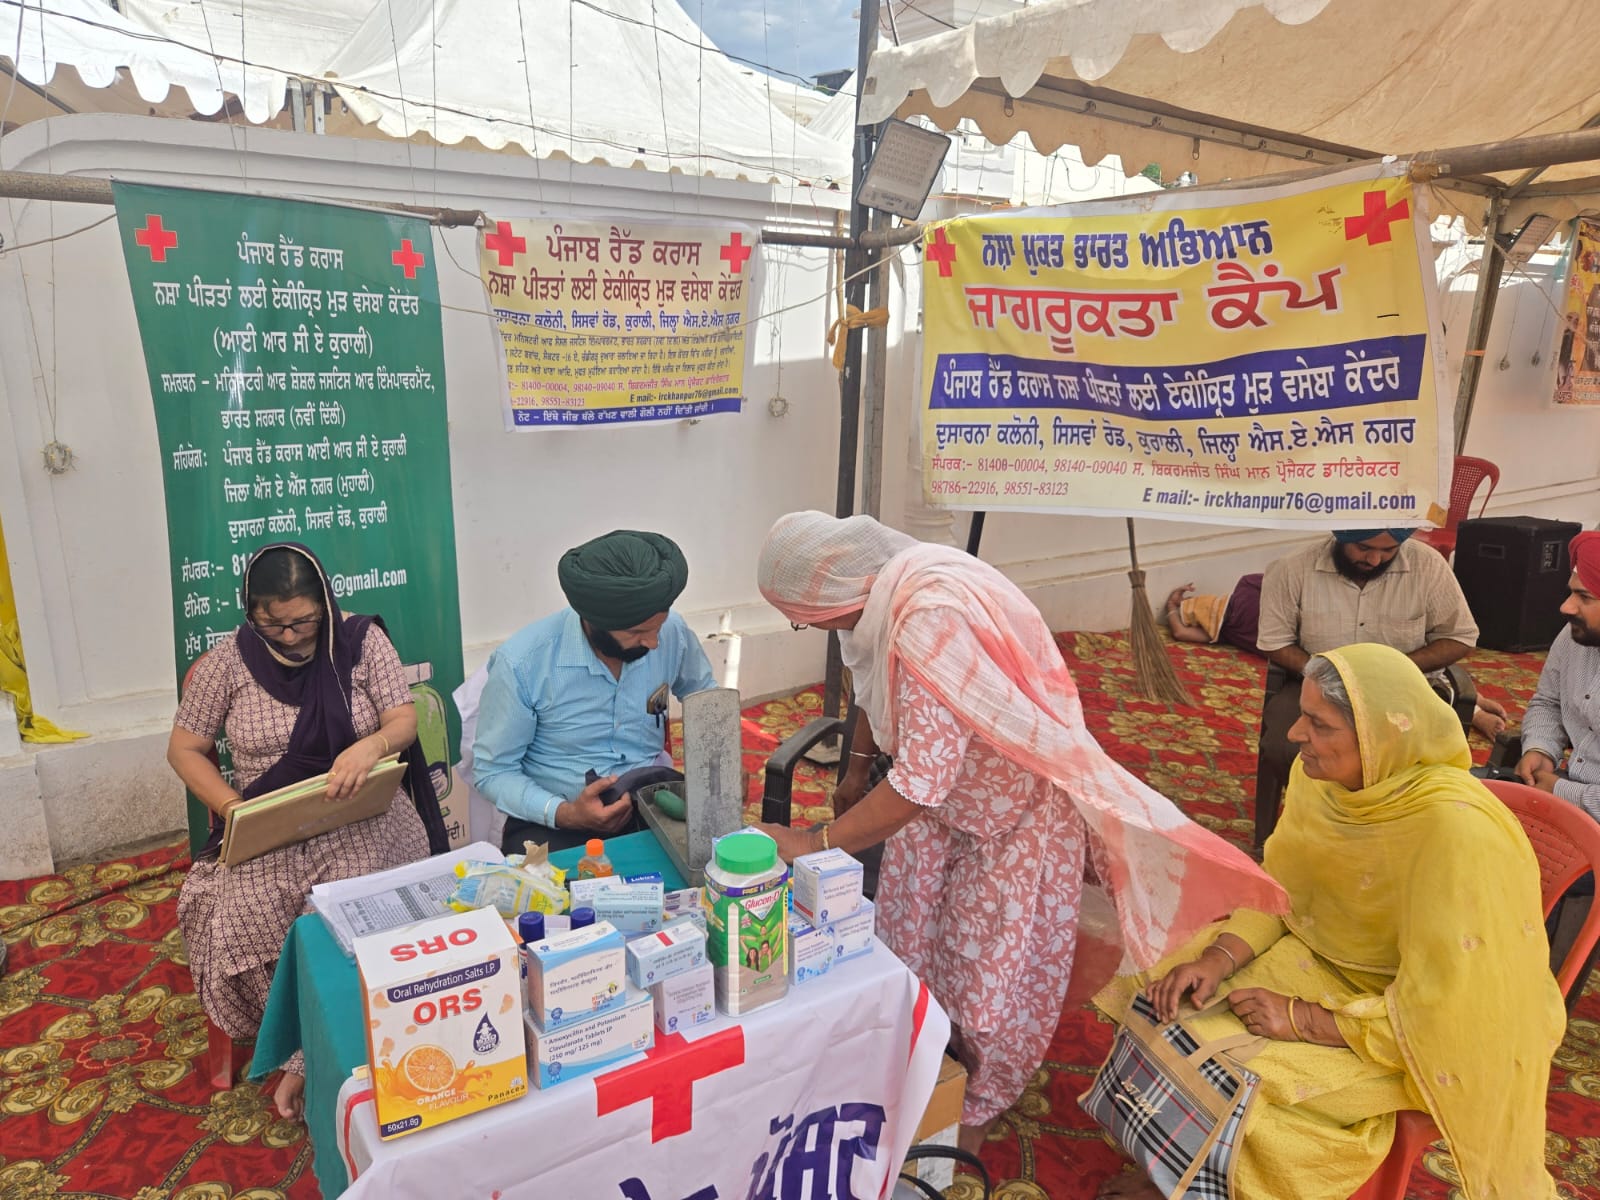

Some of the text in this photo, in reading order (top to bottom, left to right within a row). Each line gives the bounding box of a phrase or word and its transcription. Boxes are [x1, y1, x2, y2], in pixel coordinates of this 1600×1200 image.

[237, 232, 343, 270] ਪੰਜਾਬ ਰੈੱਡ ਕਰਾਸ
[546, 224, 701, 266] ਪੰਜਾਬ ਰੈੱਡ ਕਰਾਸ
[981, 217, 1272, 276] ਨਸ਼ਾ ਮੁਕਤ ਭਾਰਤ ਅਭਿਆਨ
[153, 282, 180, 306] ਨਸ਼ਾ
[187, 274, 231, 307] ਪੀੜਤਾਂ
[238, 278, 267, 308] ਲਈ
[327, 290, 347, 317] ਮੁੜ
[352, 285, 383, 314] ਵਸੇਬਾ
[388, 287, 418, 315] ਕੇਂਦਰ
[488, 270, 516, 297] ਨਸ਼ਾ
[522, 268, 565, 301] ਪੀੜਤਾਂ
[571, 269, 597, 301] ਲਈ
[656, 280, 676, 307] ਮੁੜ
[681, 272, 713, 302] ਵਸੇਬਾ
[718, 272, 742, 299] ਕੇਂਦਰ
[572, 310, 599, 328] ਸਿਸਵਾਂ
[602, 310, 620, 330] ਰੋਡ,
[964, 262, 1341, 354] ਜਾਗਰੂਕਤਾ ਕੈਂਪ
[213, 323, 373, 359] (ਆਈ ਆਰ ਸੀ ਏ ਕੁਰਾਲੀ)
[161, 373, 196, 393] ਸਮਰਥਨ
[267, 372, 286, 392] ਆਫ
[319, 366, 351, 391] ਜਸਟਿਸ
[354, 371, 374, 390] ਆਫ
[944, 358, 983, 400] ਪੰਜਾਬ
[988, 358, 1012, 400] ਰੈੱਡ
[1017, 370, 1052, 400] ਕਰਾਸ
[1053, 374, 1080, 400] ਨਸ਼ਾ
[1082, 368, 1121, 407] ਪੀੜਤਾਂ
[1126, 373, 1161, 411] ਲਈ
[1243, 372, 1273, 414] ਮੁੜ
[1280, 356, 1335, 402] ਵਸੇਬਾ
[1343, 350, 1400, 394] ਕੇਂਦਰ
[221, 410, 250, 429] ਭਾਰਤ
[255, 408, 285, 427] ਸਰਕਾਰ
[320, 401, 346, 428] ਦਿੱਲੀ)
[223, 442, 252, 466] ਪੰਜਾਬ
[257, 438, 272, 464] ਰੈੱਡ
[275, 444, 302, 462] ਕਰਾਸ
[307, 436, 329, 460] ਆਈ
[333, 440, 352, 459] ਆਰ
[356, 435, 367, 458] ਸੀ
[371, 436, 379, 456] ਏ
[382, 433, 407, 461] ਕੁਰਾਲੀ
[936, 424, 991, 450] ਦੁਸਾਰਨਾ
[998, 414, 1044, 450] ਕਲੋਨੀ,
[1053, 416, 1096, 446] ਸਿਸਵਾਂ
[1103, 418, 1133, 452] ਰੋਡ,
[1136, 427, 1193, 458] ਕੁਰਾਲੀ,
[1363, 418, 1416, 444] ਨਗਰ
[1053, 458, 1127, 475] 98140-09040
[1247, 466, 1270, 480] ਮਾਨ
[1323, 456, 1400, 478] ਡਾਇਰੈਕਟਰ
[275, 474, 284, 497] ਏ
[310, 477, 332, 495] ਨਗਰ
[932, 480, 1069, 496] 98786-22916, 98551-83123
[1143, 488, 1152, 502] E
[1204, 491, 1416, 513] irckhanpur76@gmail.com
[305, 506, 334, 530] ਸਿਸਵਾਂ
[337, 504, 355, 530] ਰੋਡ,
[359, 500, 387, 528] ਕੁਰਾਲੀ
[184, 592, 210, 618] ਈਮੇਲ
[328, 567, 407, 597] @gmail.com
[745, 890, 780, 910] Glucon-D
[390, 928, 477, 962] ORS
[393, 984, 412, 1000] Oral
[414, 974, 463, 995] Rehydration
[465, 967, 484, 980] Salts
[412, 988, 482, 1025] ORS
[585, 1023, 595, 1032] and
[597, 1014, 626, 1027] Potassium
[579, 1042, 589, 1051] 125
[417, 1088, 456, 1105] ORANGE
[429, 1093, 469, 1110] FLAVOUR
[488, 1085, 525, 1102] Panacea
